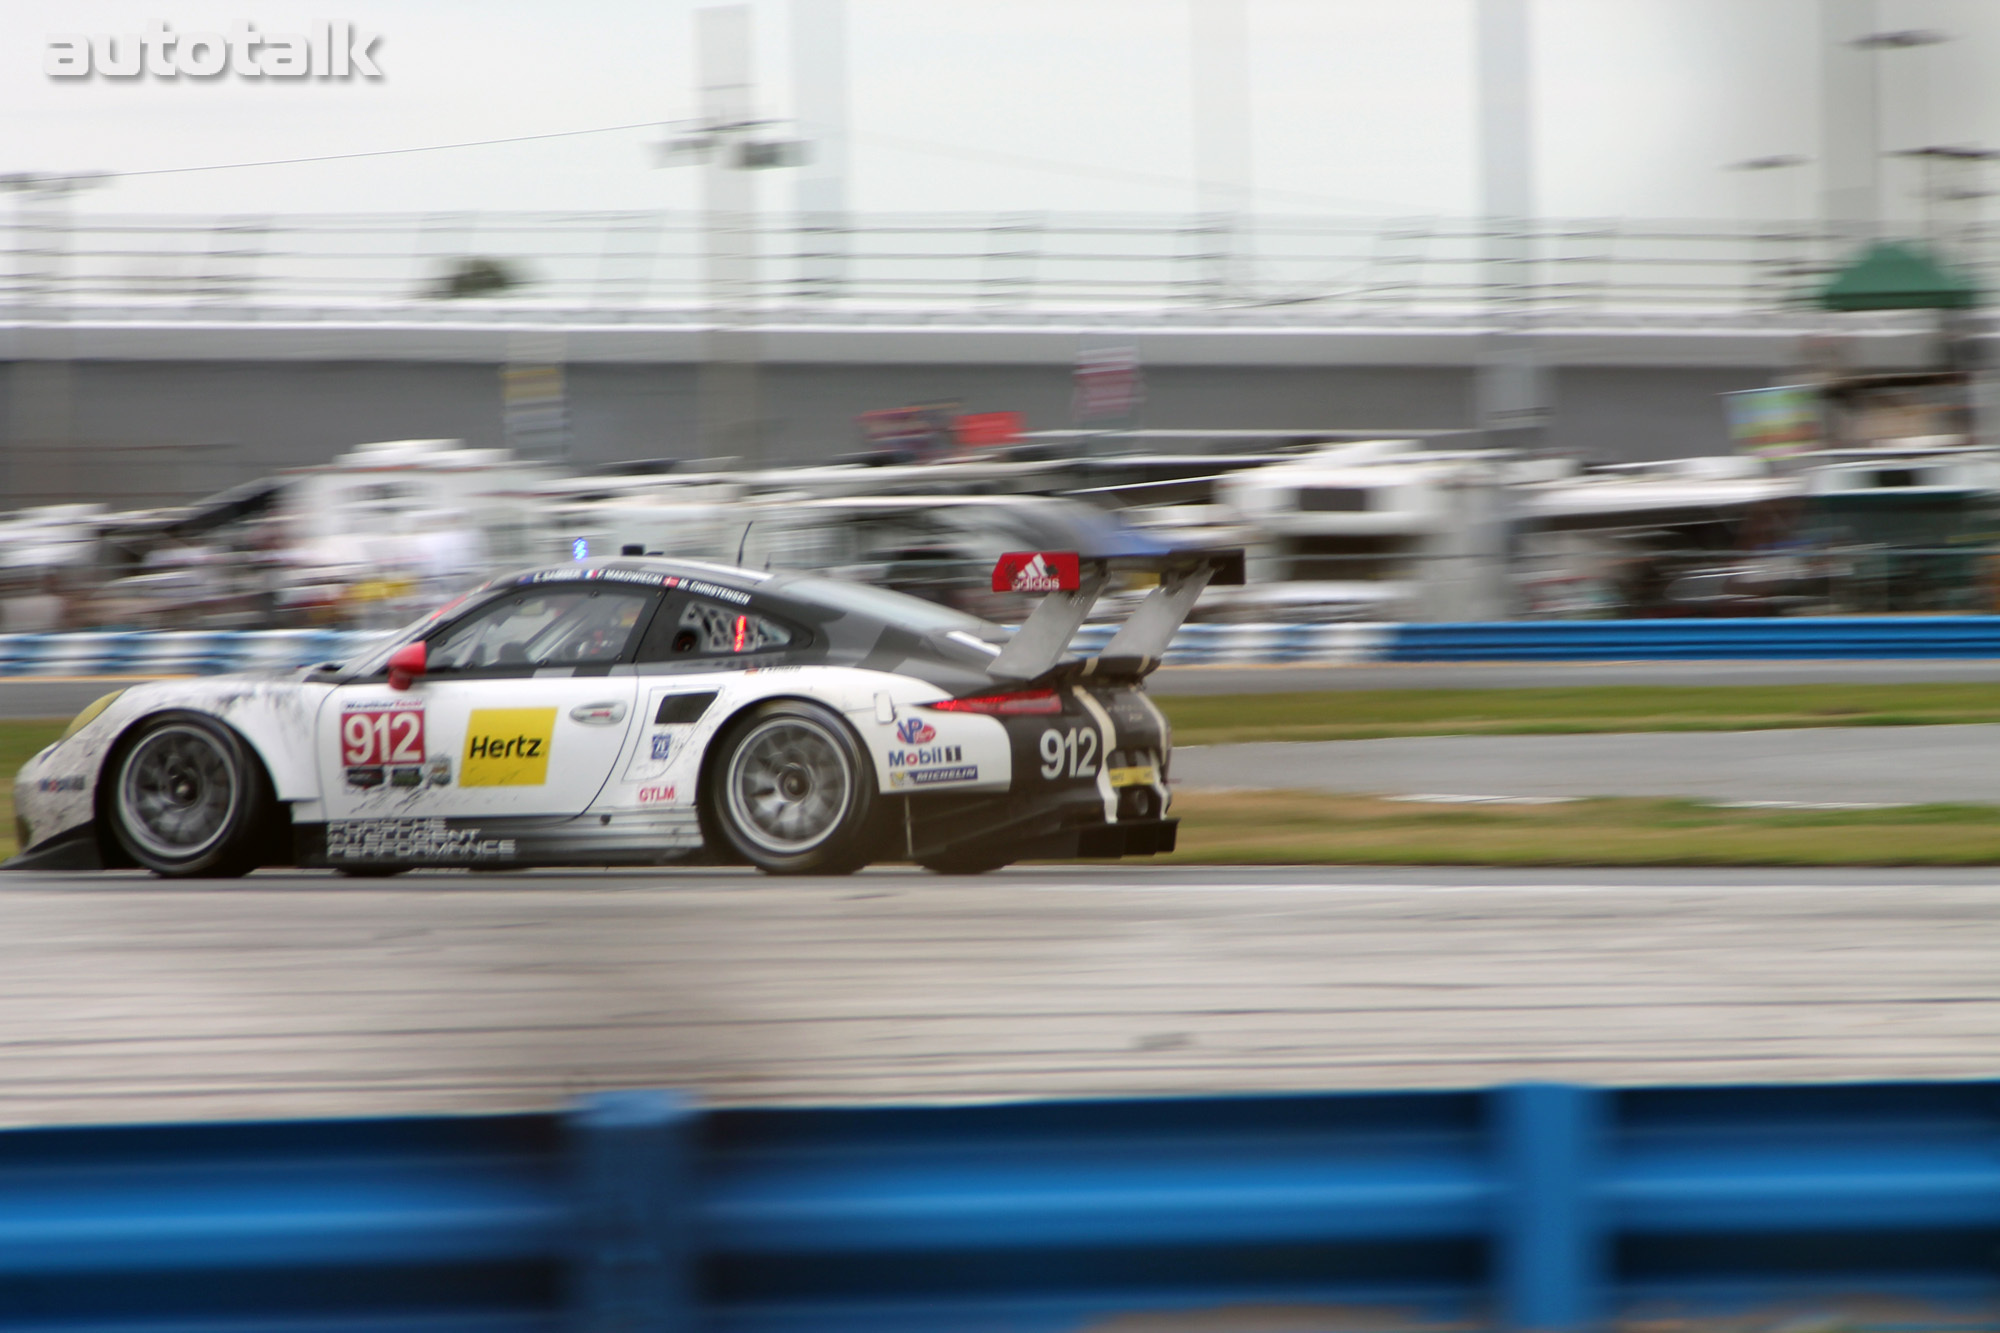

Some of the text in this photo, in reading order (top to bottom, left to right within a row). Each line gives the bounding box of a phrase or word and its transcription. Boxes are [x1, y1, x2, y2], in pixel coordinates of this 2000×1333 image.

[1012, 577, 1060, 592] adidas
[344, 711, 423, 764] 912
[897, 717, 923, 744] VP
[469, 735, 542, 759] Hertz
[888, 746, 943, 767] Mobil
[1040, 726, 1098, 780] 912
[916, 767, 977, 783] MICHELIN
[639, 786, 676, 802] GTLM
